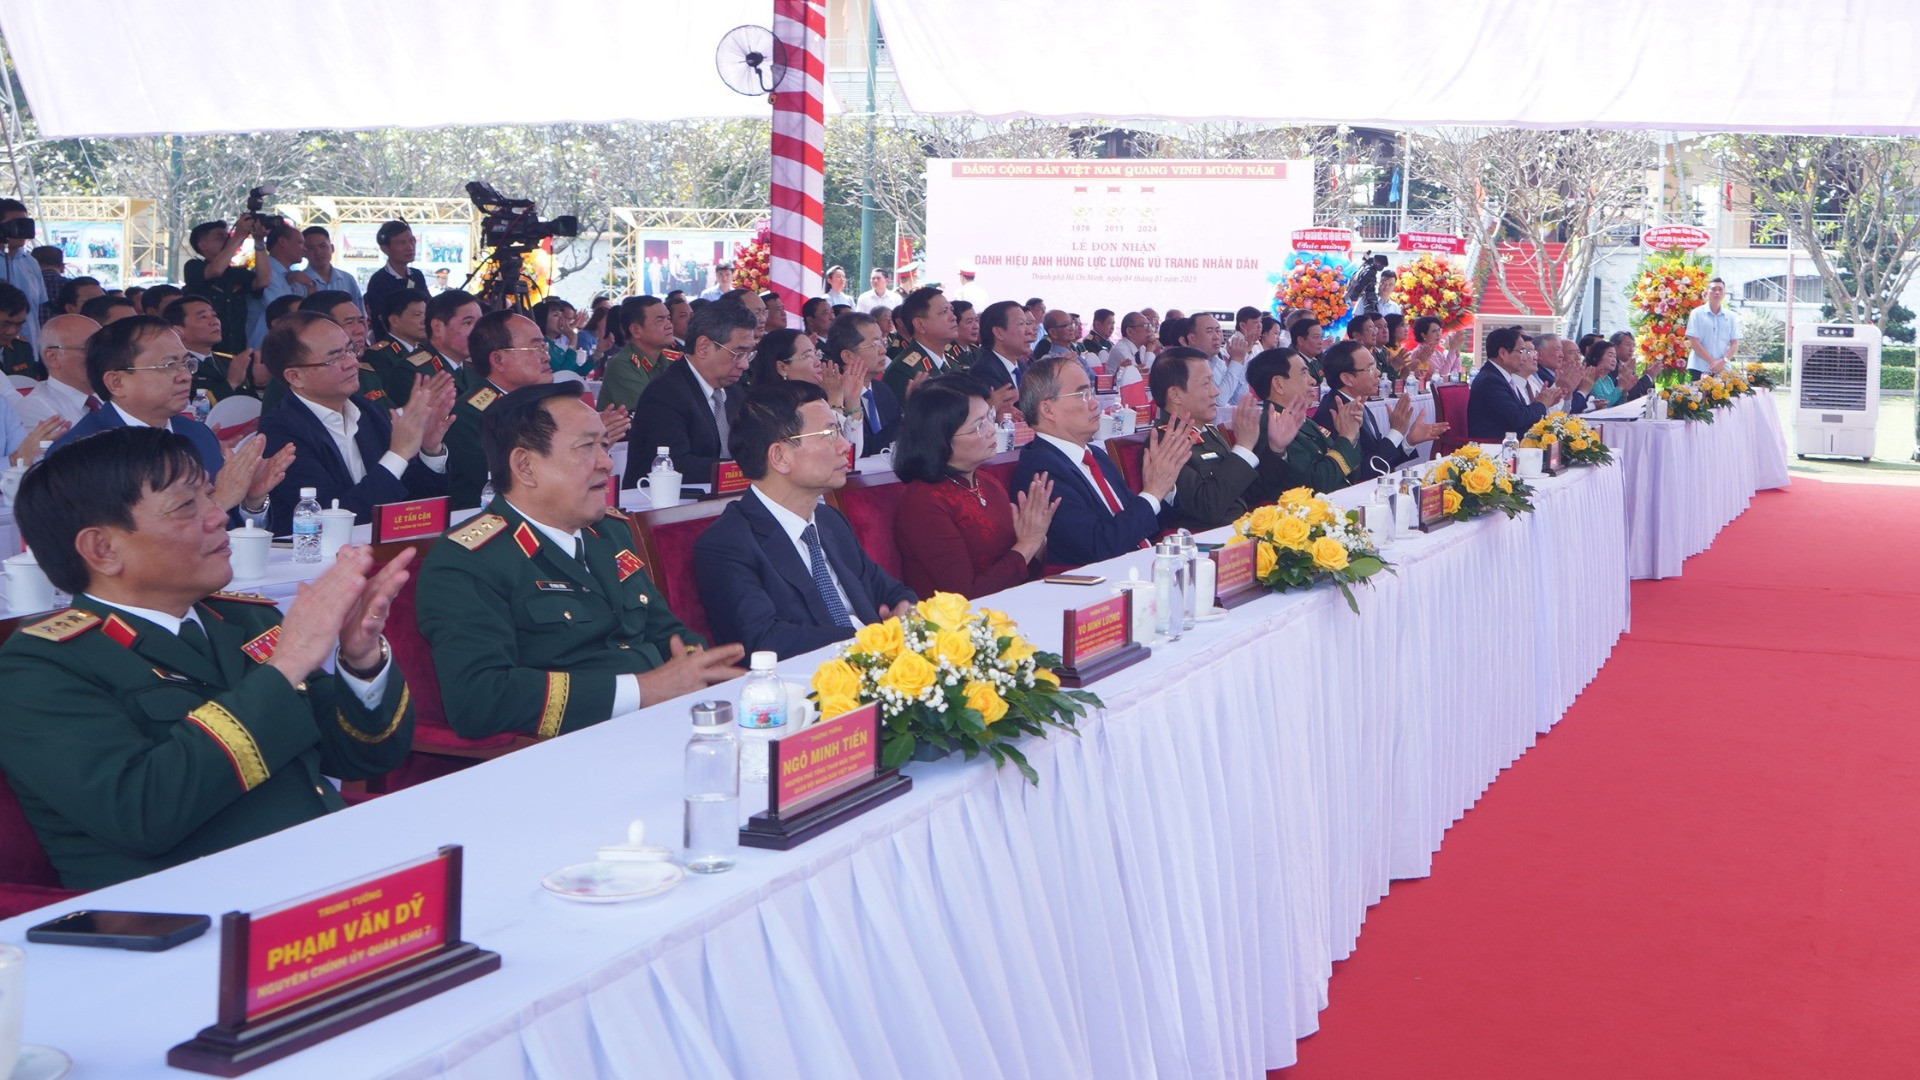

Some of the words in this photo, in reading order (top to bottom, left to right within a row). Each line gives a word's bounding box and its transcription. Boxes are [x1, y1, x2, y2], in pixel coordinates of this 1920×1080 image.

[962, 163, 996, 175] ĐẢNG
[999, 165, 1032, 177] CỘNG
[1035, 163, 1060, 175] SẢN
[1063, 164, 1091, 177] VIỆT
[1094, 165, 1122, 175] NAM
[1124, 165, 1168, 177] QUANG
[1171, 165, 1202, 175] VINH
[1205, 164, 1243, 176] MUÔN
[1246, 164, 1275, 176] NĂM
[975, 255, 1002, 266] DANH
[1005, 253, 1029, 268] HIỆU
[1032, 256, 1053, 267] ANH
[1087, 255, 1107, 270] LỰC
[1110, 256, 1145, 270] LƯỢNG
[1165, 257, 1199, 268] TRANG
[1202, 256, 1233, 269] NHÂN
[1236, 256, 1259, 270] DÂN
[394, 514, 402, 523] LÊ
[404, 512, 417, 522] TẤN
[783, 750, 808, 776] NGÔ
[811, 741, 840, 765] MINH
[842, 726, 868, 751] TIẾN
[317, 899, 350, 918] TRUNG
[267, 928, 338, 971] PHẠM
[343, 910, 390, 943] VĂN
[395, 892, 426, 925] DỸ
[257, 970, 309, 999] NGUYÊN
[310, 956, 349, 979] CHÍNH
[349, 948, 366, 965] ỦY
[366, 936, 399, 957] QUÂN
[399, 929, 424, 945] KHU
[424, 925, 432, 935] 7
